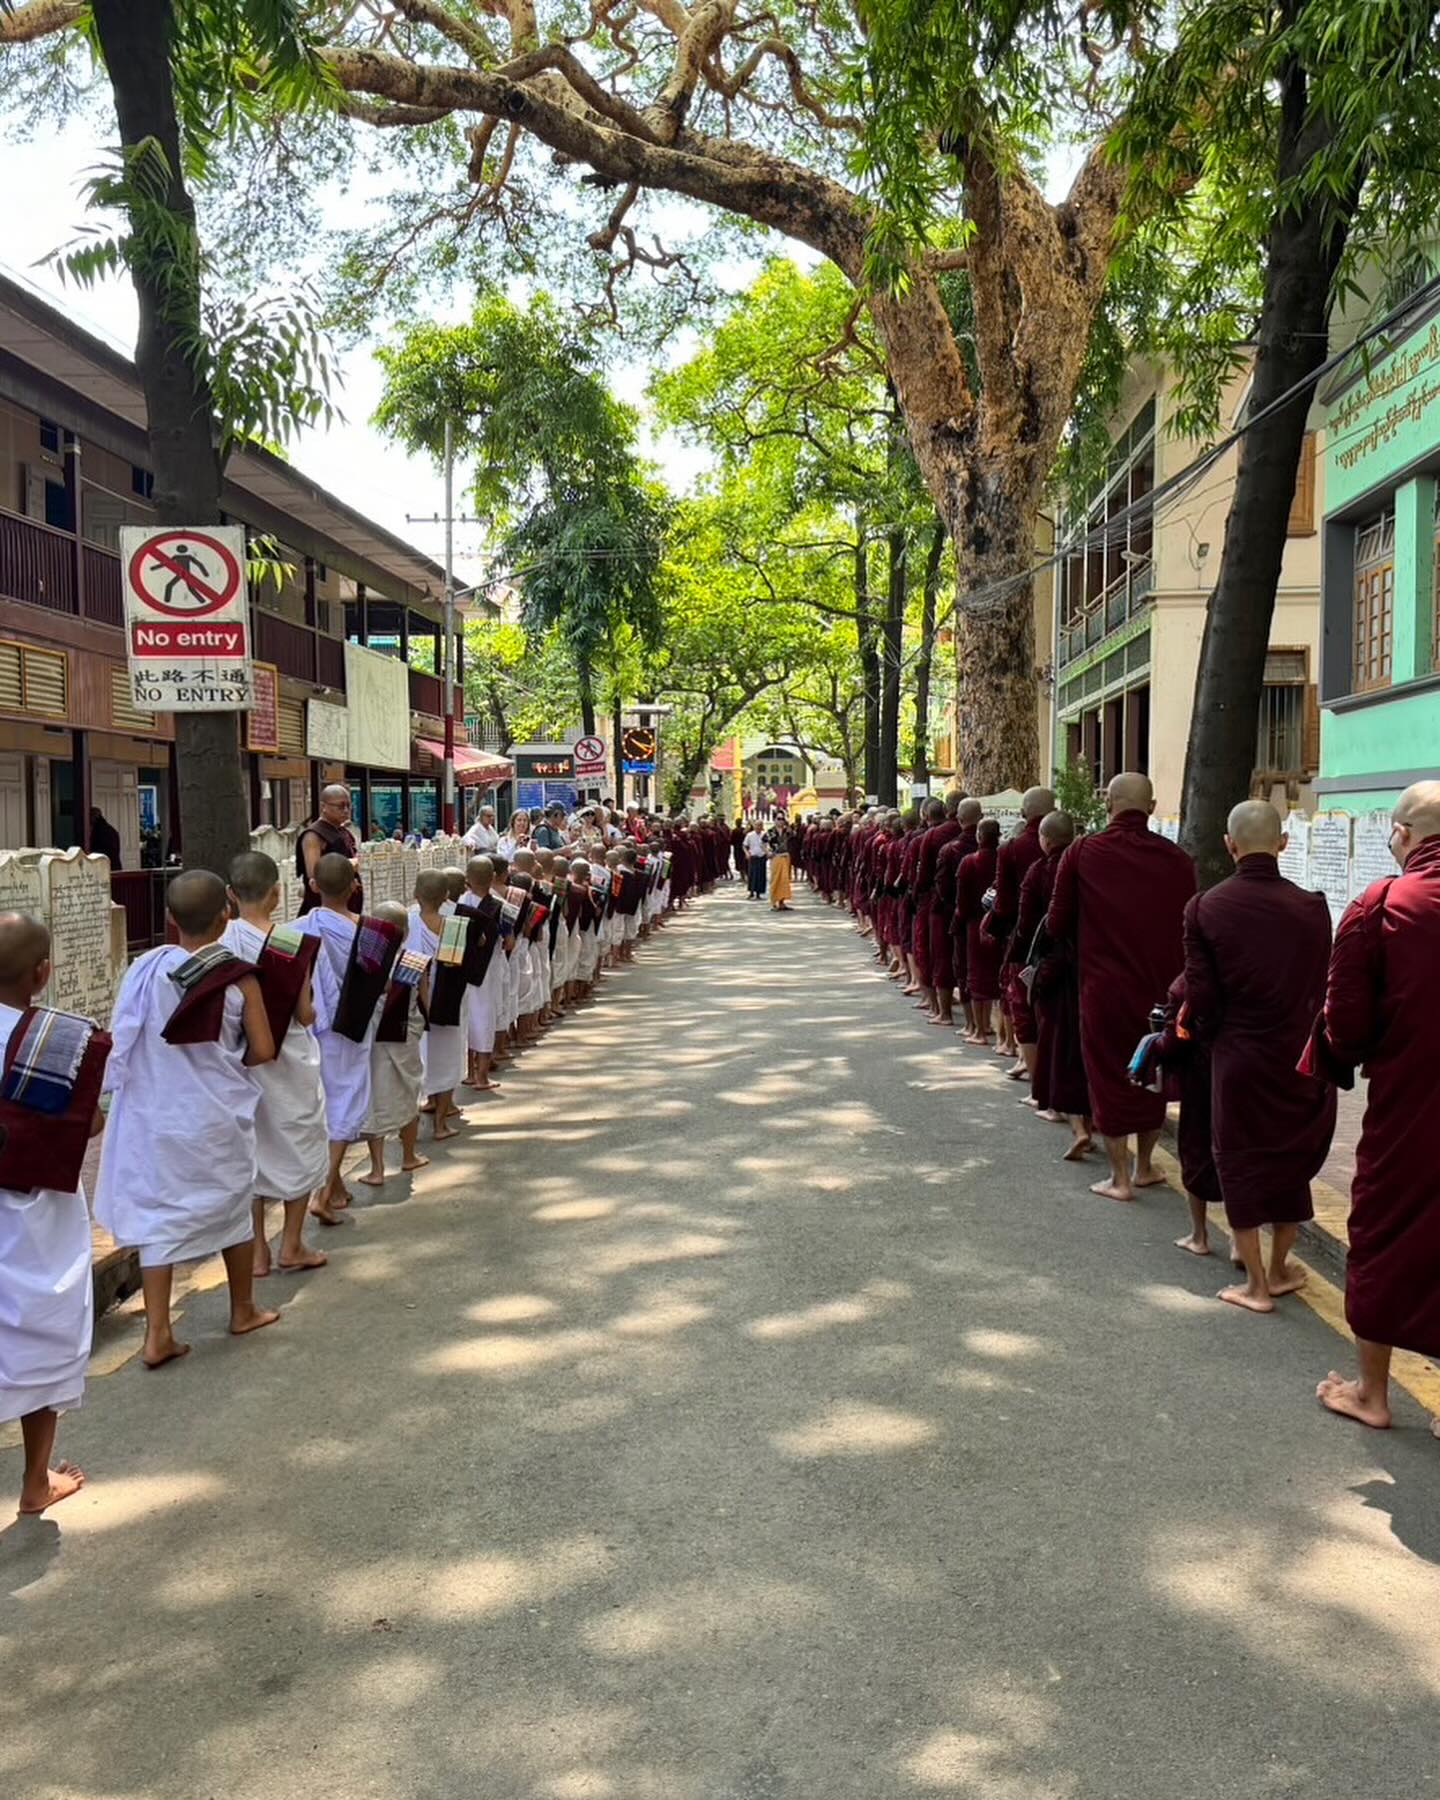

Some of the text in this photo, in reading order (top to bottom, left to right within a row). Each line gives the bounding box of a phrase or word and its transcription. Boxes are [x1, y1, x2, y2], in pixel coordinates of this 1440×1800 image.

[136, 629, 239, 650] No entry
[134, 668, 249, 687] 此路不通
[134, 687, 249, 702] NO ENTRY
